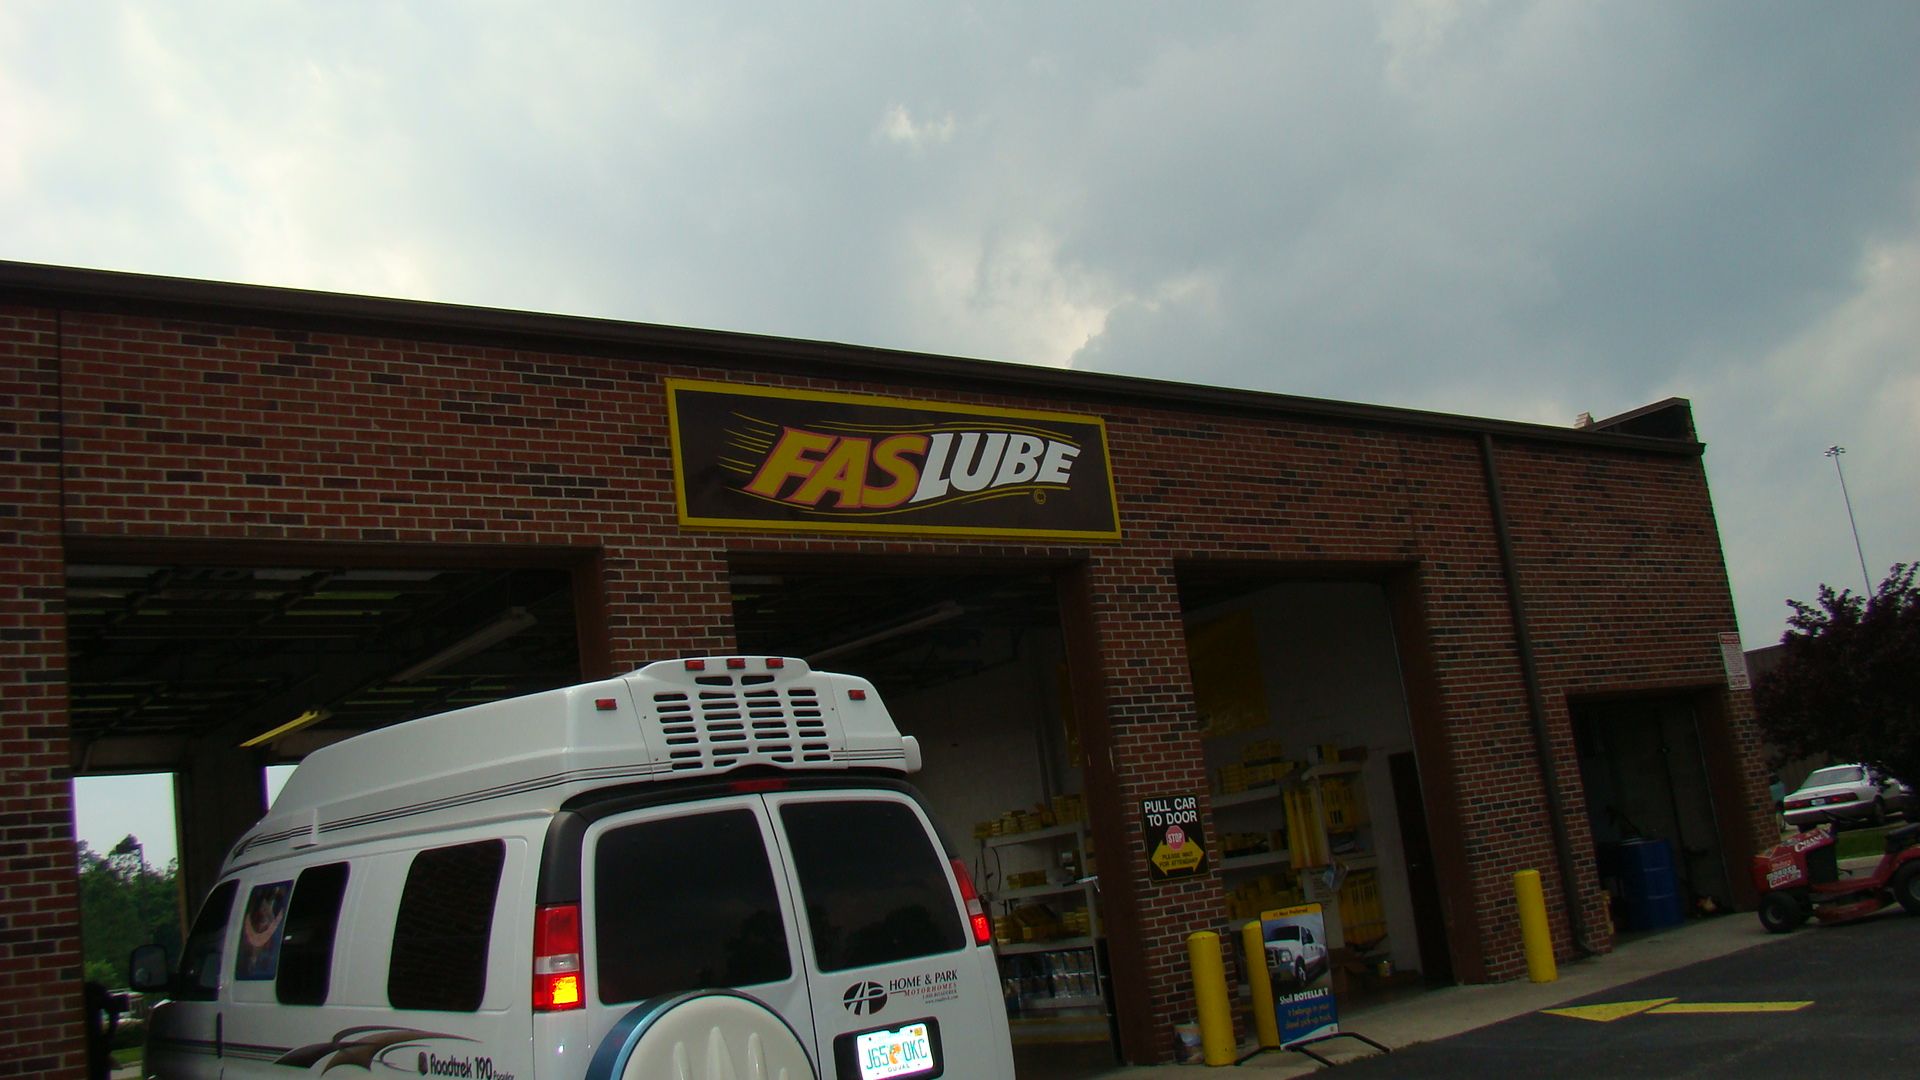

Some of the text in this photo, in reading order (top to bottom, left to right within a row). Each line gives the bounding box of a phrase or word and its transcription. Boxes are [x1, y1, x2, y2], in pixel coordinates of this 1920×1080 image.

[1144, 797, 1197, 813] PULL CAR
[1147, 811, 1197, 827] TO DOOR
[1168, 833, 1183, 844] STOP
[890, 969, 958, 991] HOME & PARK
[904, 982, 957, 997] MOTORHOMES
[1280, 993, 1293, 1005] Shell
[1293, 989, 1323, 1002] ROTELLA
[866, 1045, 889, 1070] J65
[430, 1053, 472, 1078] Roadtrek
[475, 1056, 493, 1080] 190
